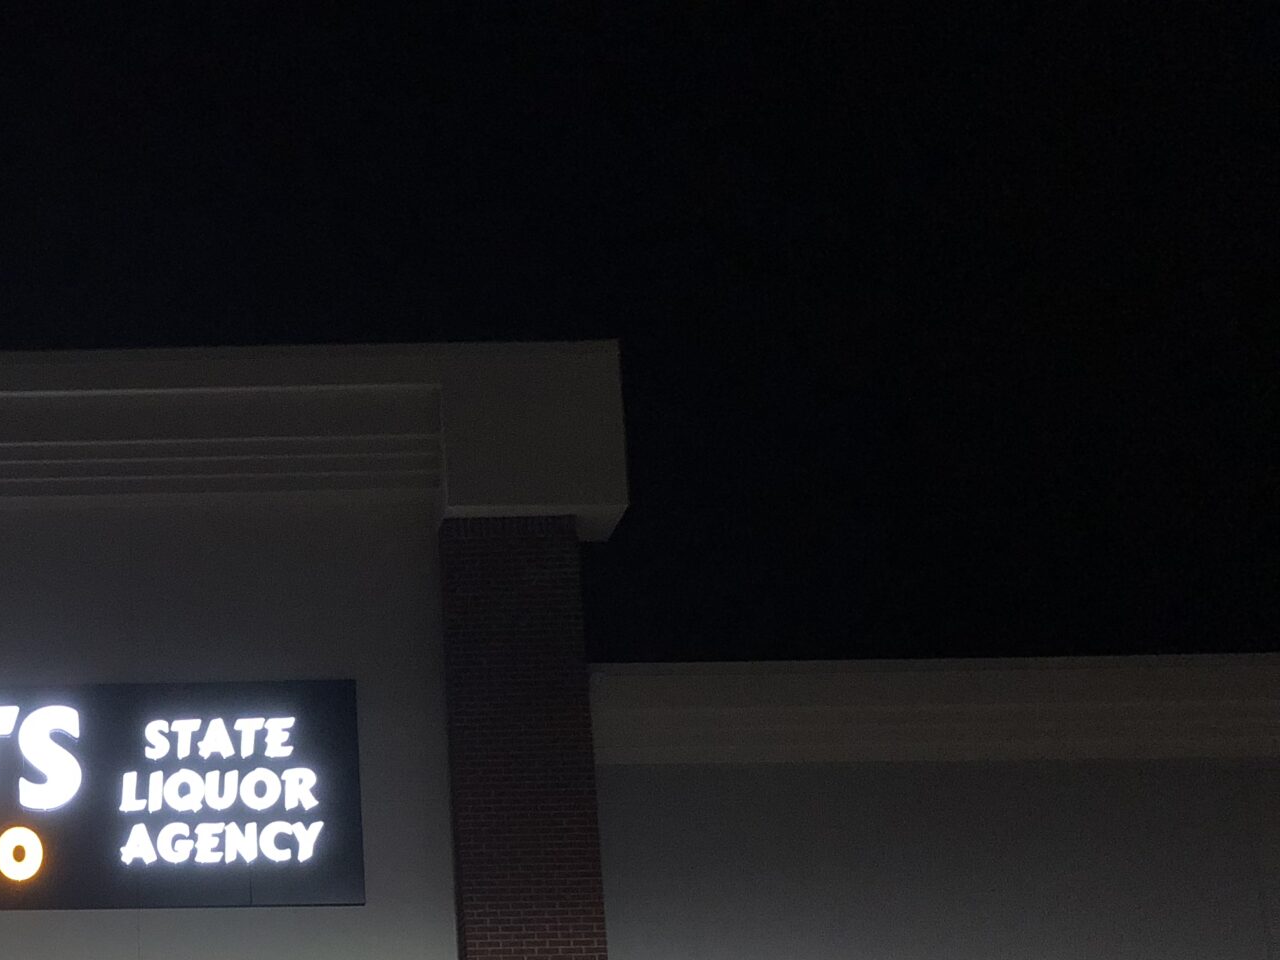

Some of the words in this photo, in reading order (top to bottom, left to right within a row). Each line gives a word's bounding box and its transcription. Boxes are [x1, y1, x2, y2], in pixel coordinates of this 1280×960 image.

[144, 716, 296, 761] STATE
[119, 767, 319, 814] LIQUOR
[119, 820, 324, 866] AGENCY
